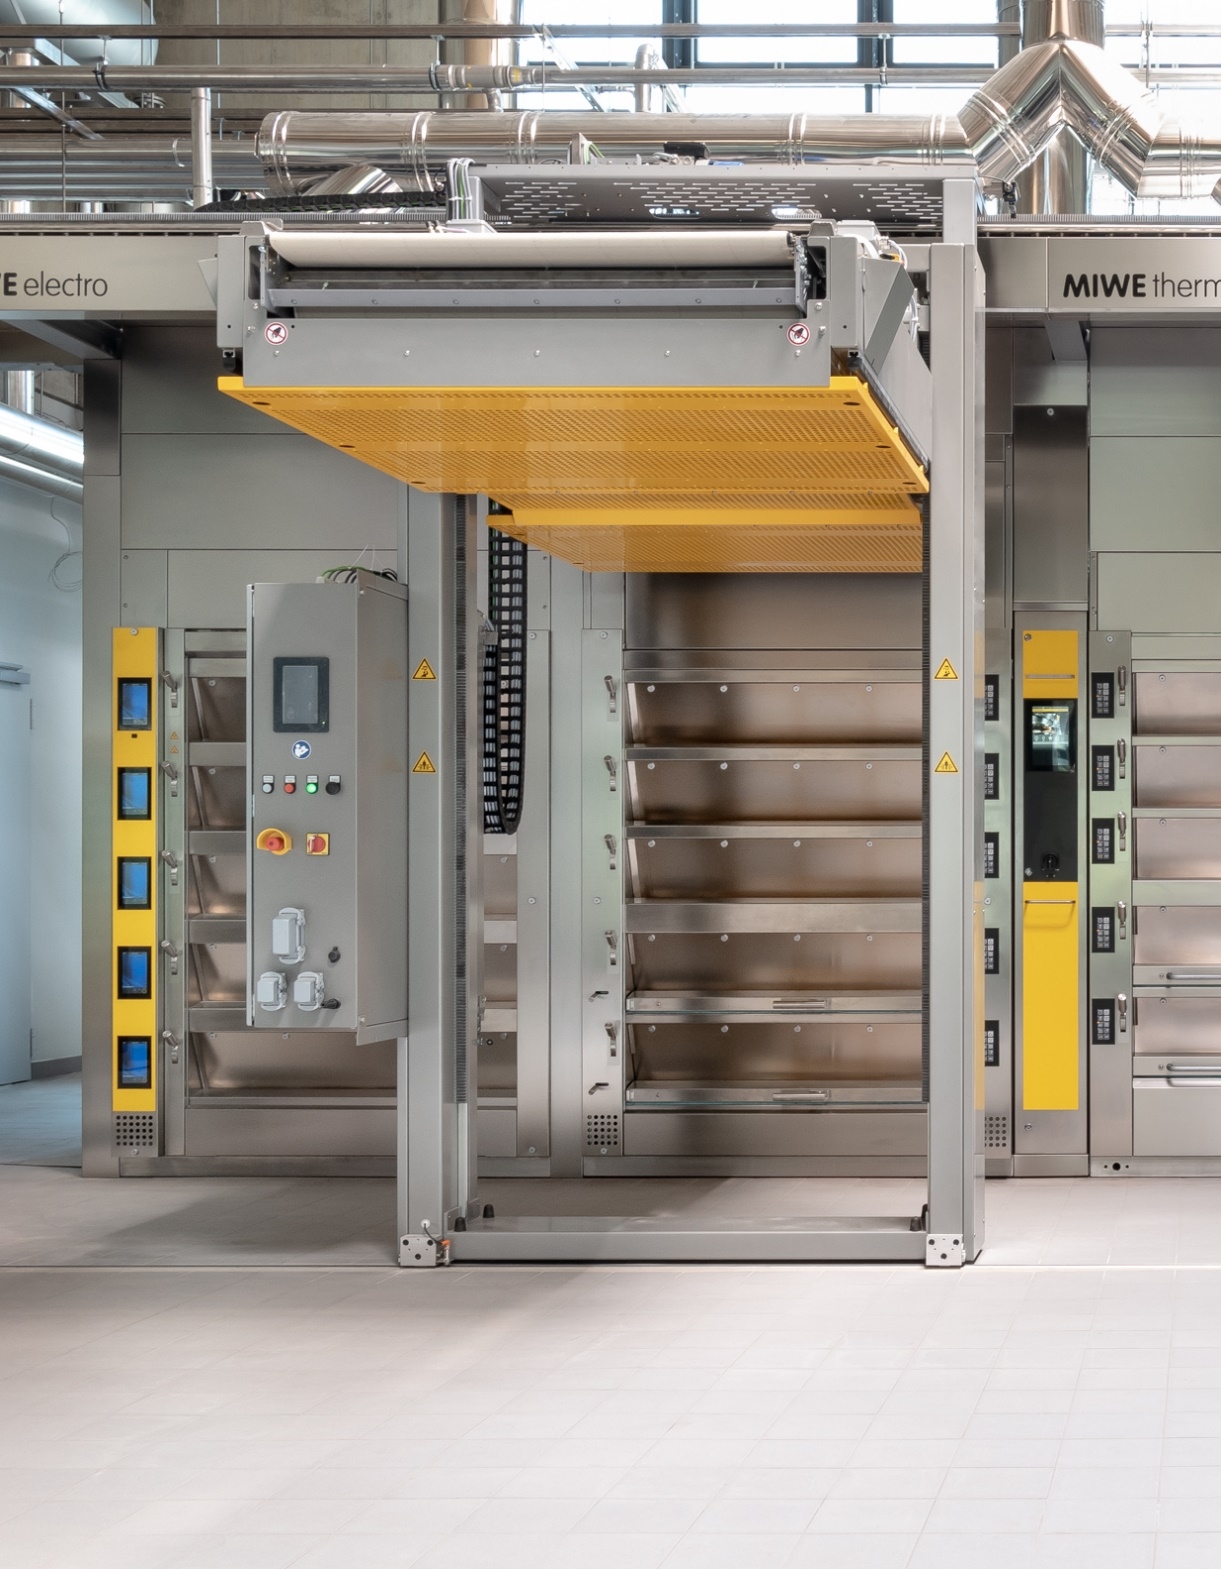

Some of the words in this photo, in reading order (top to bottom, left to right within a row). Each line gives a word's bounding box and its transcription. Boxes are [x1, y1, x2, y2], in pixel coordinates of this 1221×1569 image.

[0, 272, 17, 296] E
[23, 270, 108, 297] electro
[1063, 273, 1146, 298] MIWE
